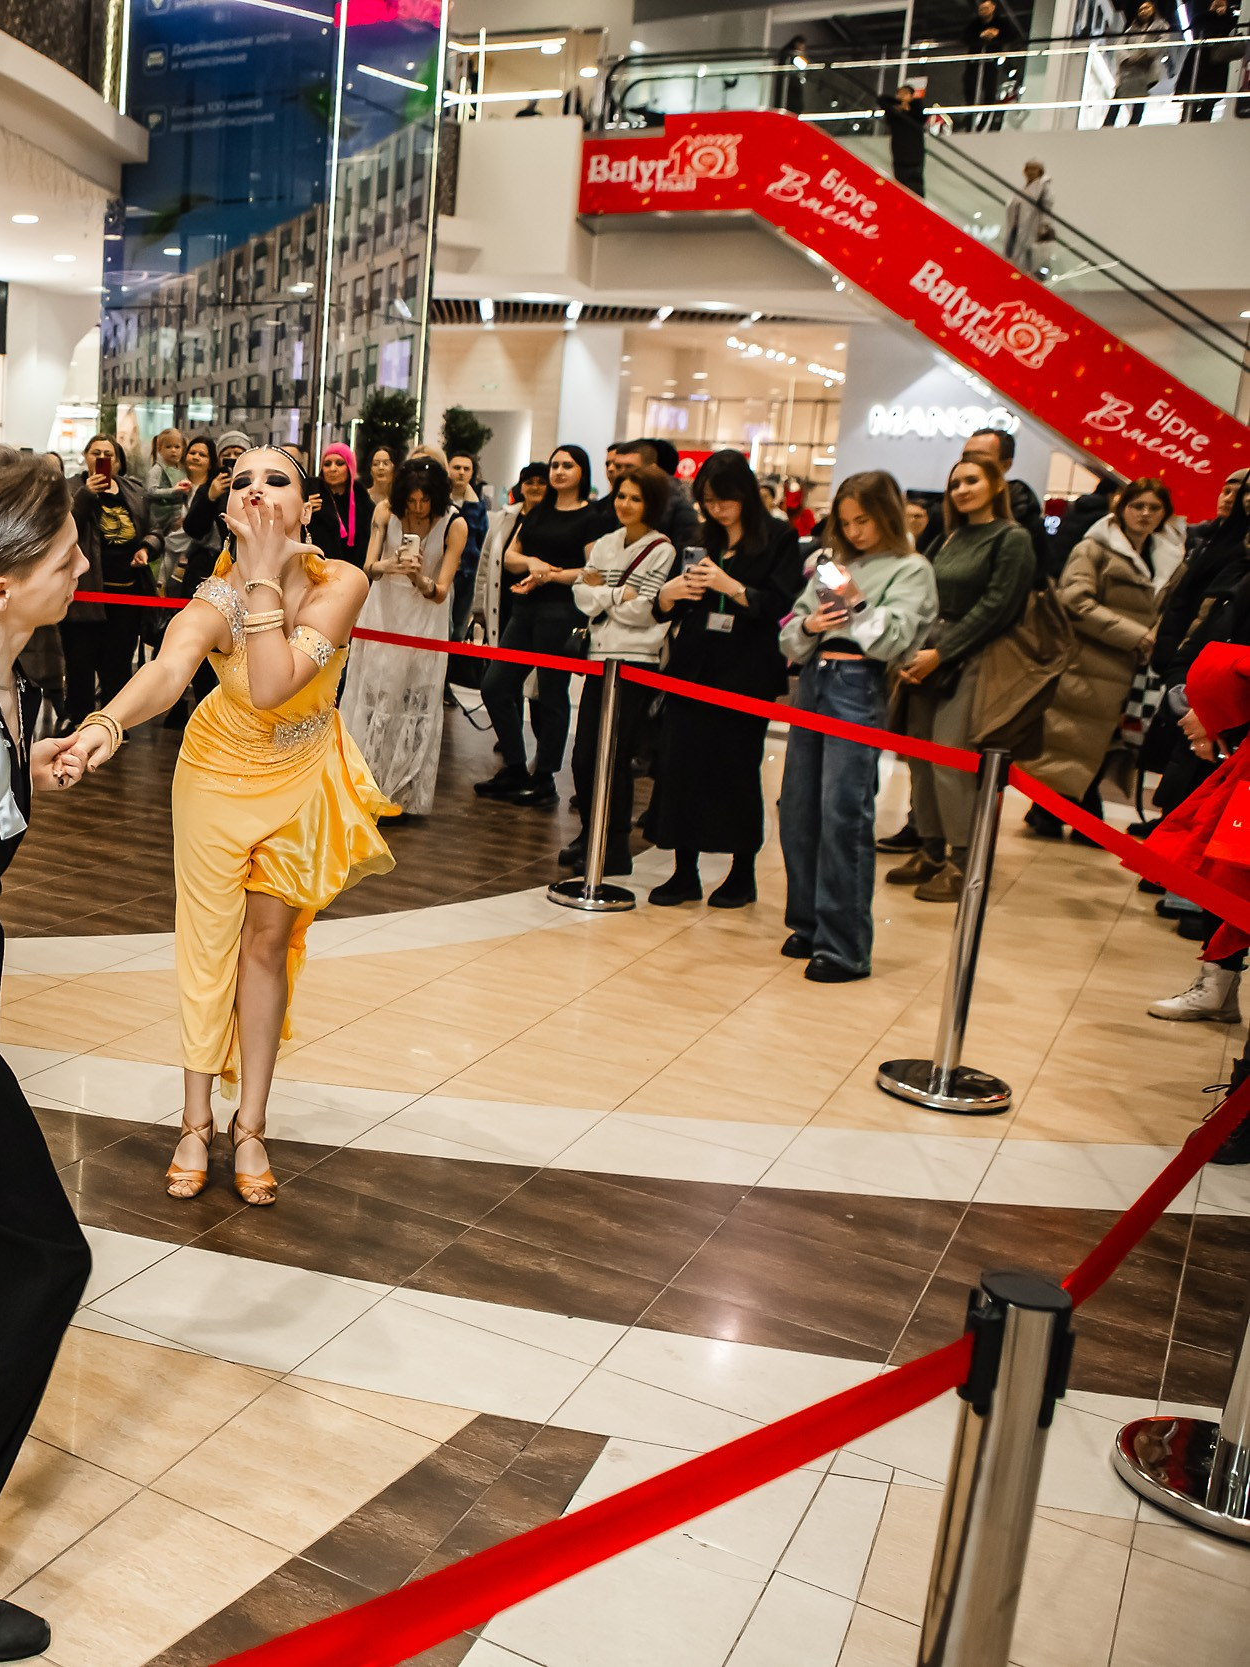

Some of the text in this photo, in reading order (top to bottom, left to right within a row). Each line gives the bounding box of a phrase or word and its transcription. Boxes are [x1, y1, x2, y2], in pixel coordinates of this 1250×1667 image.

[207, 101, 226, 112] 100
[588, 154, 669, 193] Batyr
[655, 174, 697, 192] mall
[819, 168, 878, 218] Бірге
[764, 163, 879, 239] Вместе
[909, 260, 992, 334] Batyr
[958, 322, 1002, 358] mall
[1082, 391, 1212, 474] Вместе
[1145, 399, 1210, 452] Бірге
